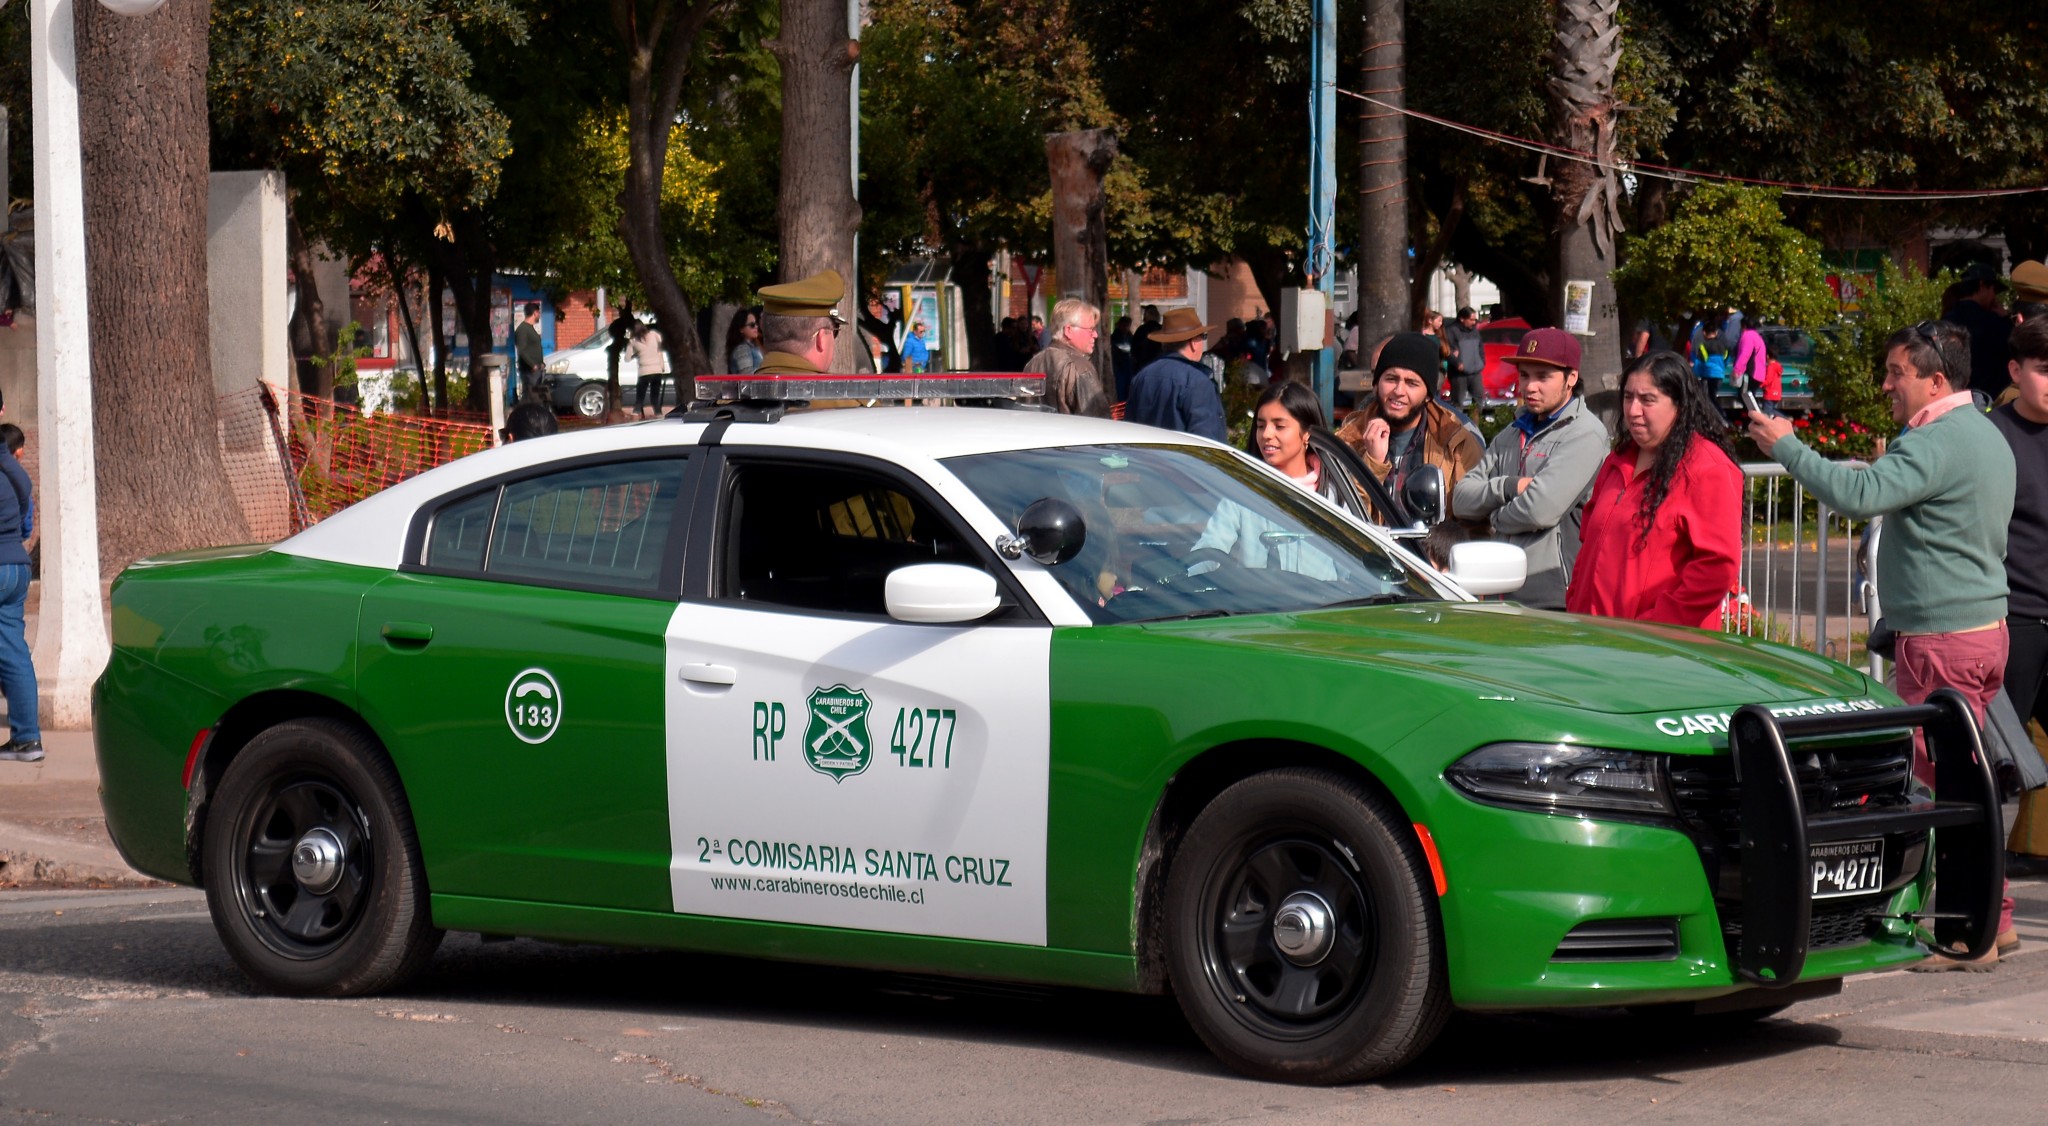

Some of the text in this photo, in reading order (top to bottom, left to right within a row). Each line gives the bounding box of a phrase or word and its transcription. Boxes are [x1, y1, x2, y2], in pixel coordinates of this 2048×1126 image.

[1527, 339, 1538, 353] B
[815, 697, 863, 708] CARABINEROS DE
[830, 706, 847, 715] CHILE
[515, 704, 552, 728] 133
[753, 701, 957, 769] RP 4277
[1810, 842, 1876, 857] ARABINEROS DE CHILE
[727, 838, 857, 875] COMISARIA
[865, 848, 939, 882] SANTA
[945, 855, 1012, 887] CRUZ
[1834, 857, 1880, 891] 4277
[711, 877, 925, 905] www.carabinerosdechile.cl
